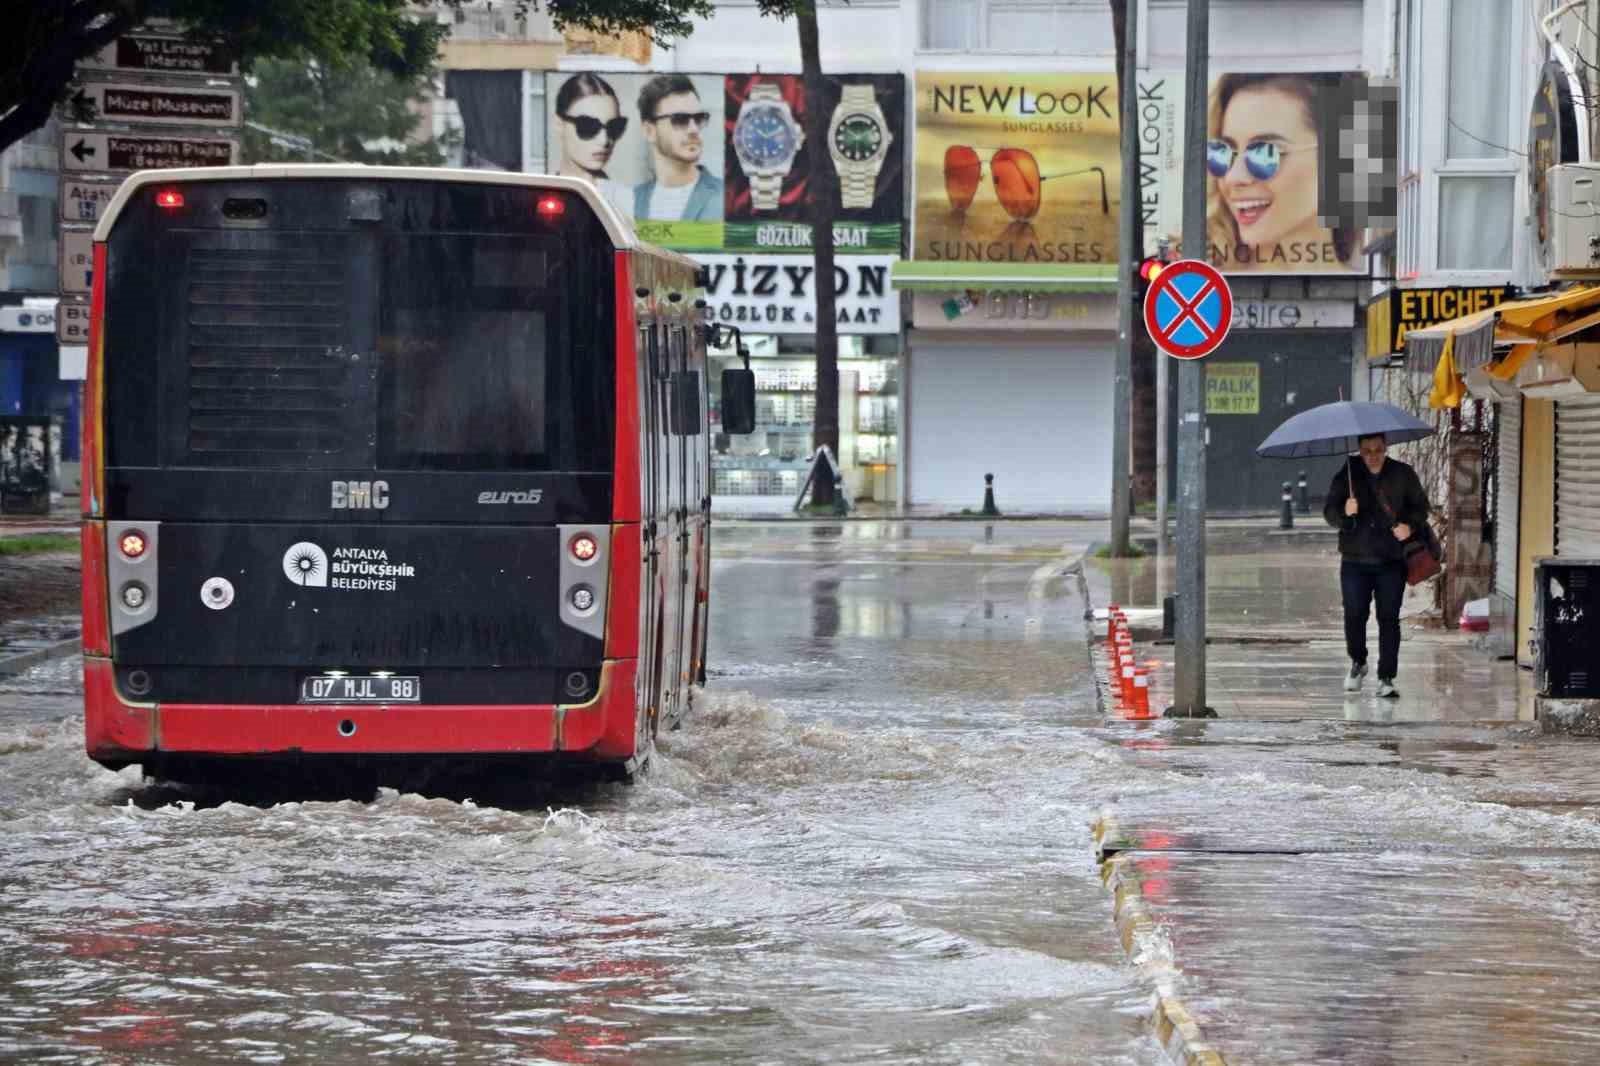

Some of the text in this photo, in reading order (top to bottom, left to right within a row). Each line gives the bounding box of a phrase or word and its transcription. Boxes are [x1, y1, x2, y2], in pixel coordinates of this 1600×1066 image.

[107, 95, 231, 116] Müze (Museum)
[934, 85, 1015, 113] NEW
[1019, 85, 1112, 119] LOOK
[1002, 121, 1084, 133] SUNGLASSES
[1138, 79, 1165, 226] NEW LOOK
[756, 223, 869, 246] GÖZLÜK SAAT
[928, 242, 1103, 263] SUNGLASSES
[837, 308, 881, 323] AAT
[1232, 302, 1301, 328] esire
[1207, 377, 1257, 393] RALIK
[331, 480, 390, 510] BMC
[477, 488, 543, 505] euro6
[332, 547, 388, 561] ANTALYA
[331, 559, 415, 578] BÜYÜKŞEHİR
[331, 576, 397, 592] BELEDİYESİ
[312, 679, 336, 698] 07
[391, 680, 413, 698] 88
